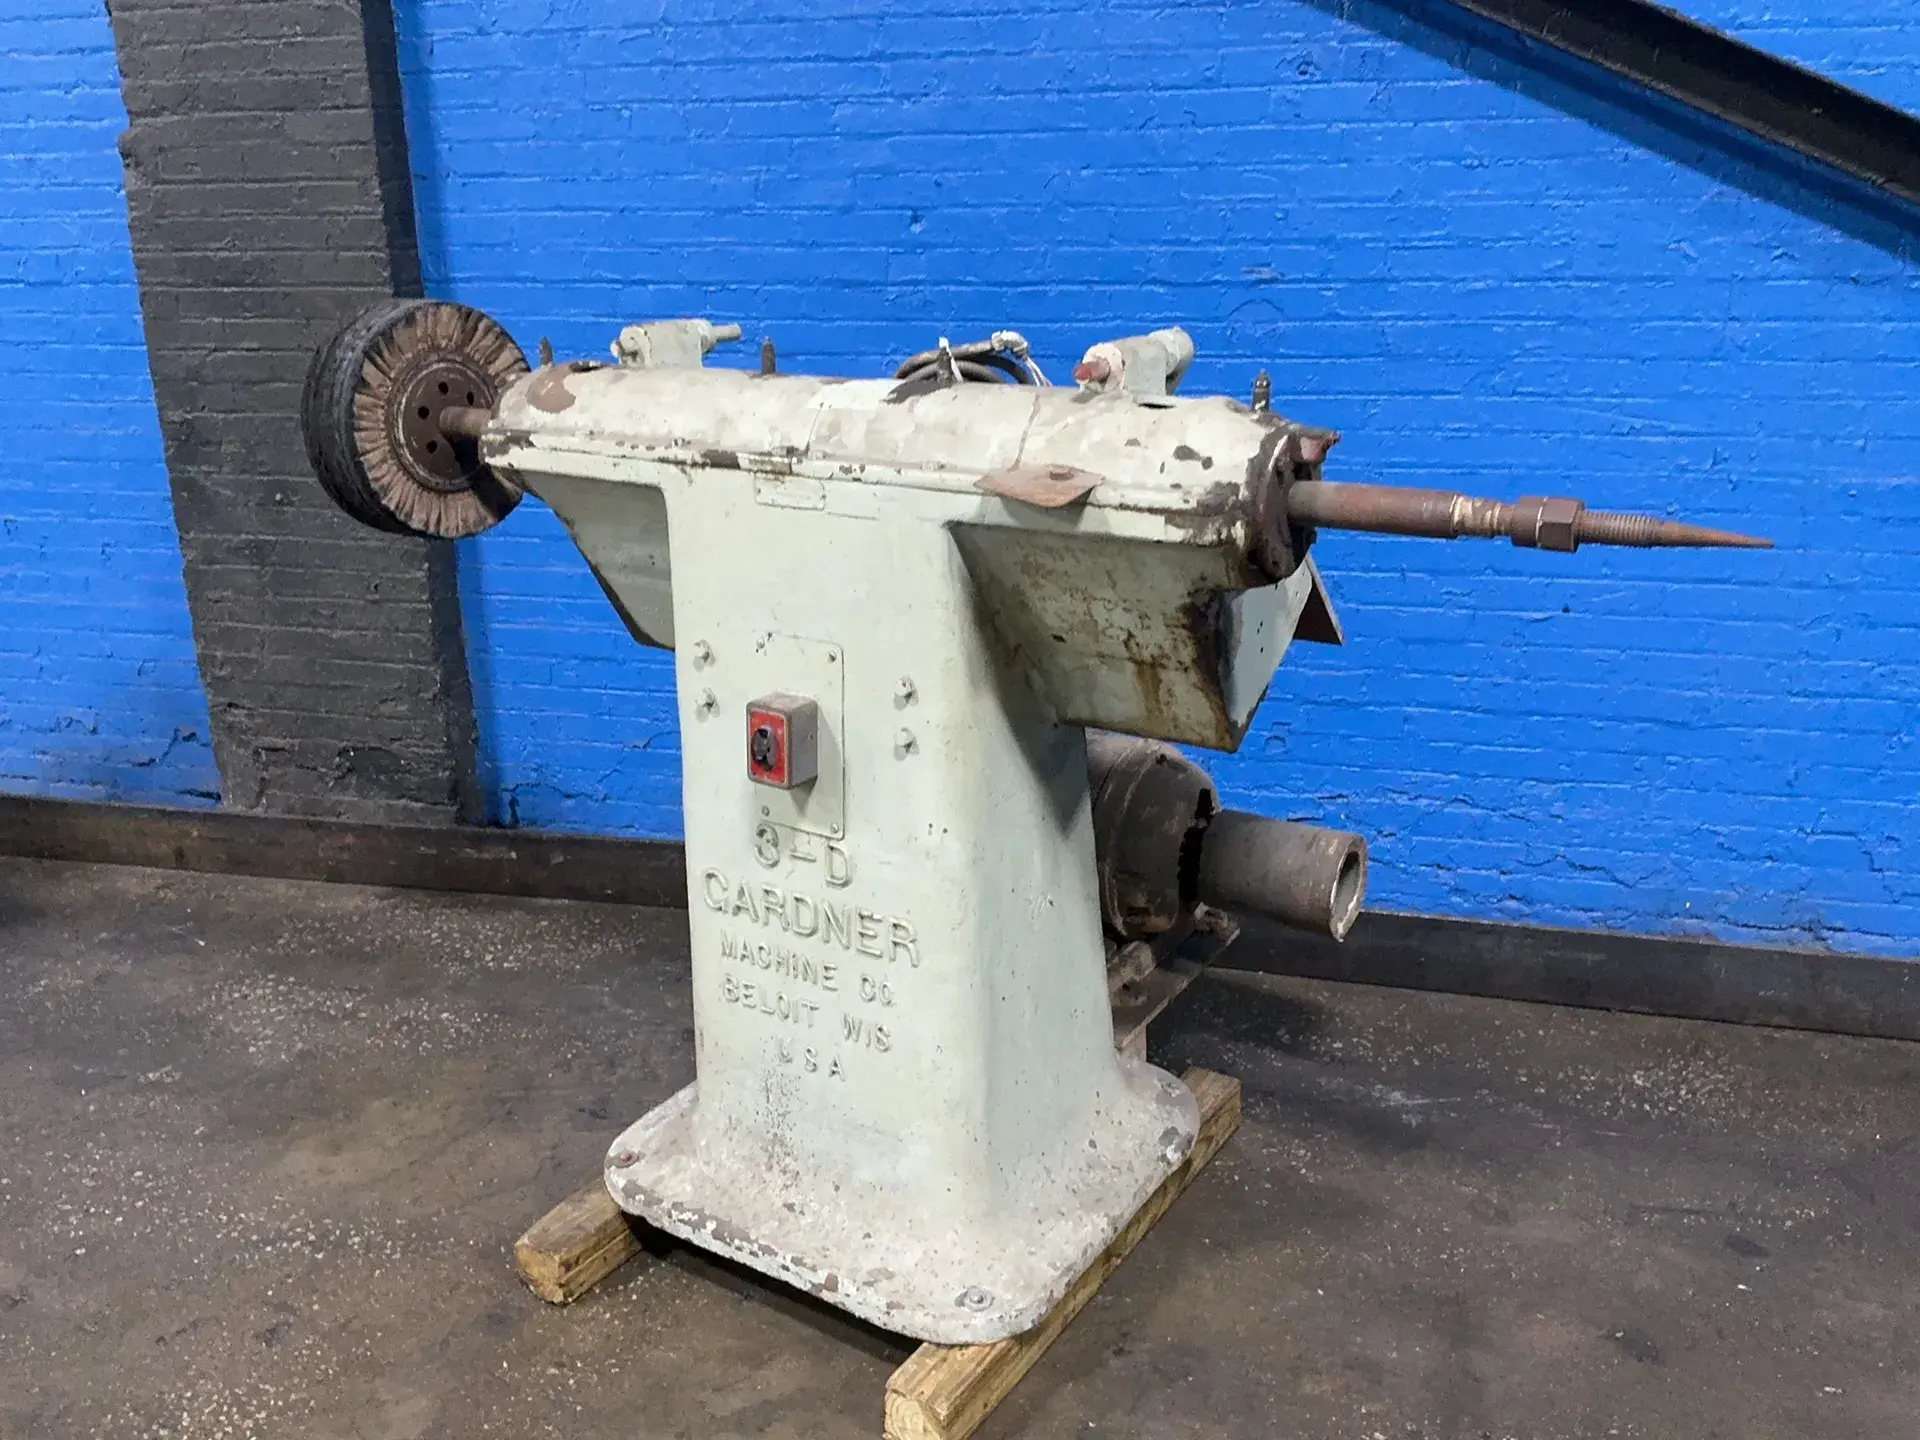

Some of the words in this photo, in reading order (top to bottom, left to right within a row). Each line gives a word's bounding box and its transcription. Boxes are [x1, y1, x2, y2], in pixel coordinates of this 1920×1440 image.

[703, 868, 921, 969] GARDNER
[720, 928, 839, 992] MACHINE
[859, 972, 897, 1008] CO
[722, 971, 820, 1030] BELOIT
[841, 1010, 892, 1054] WIS
